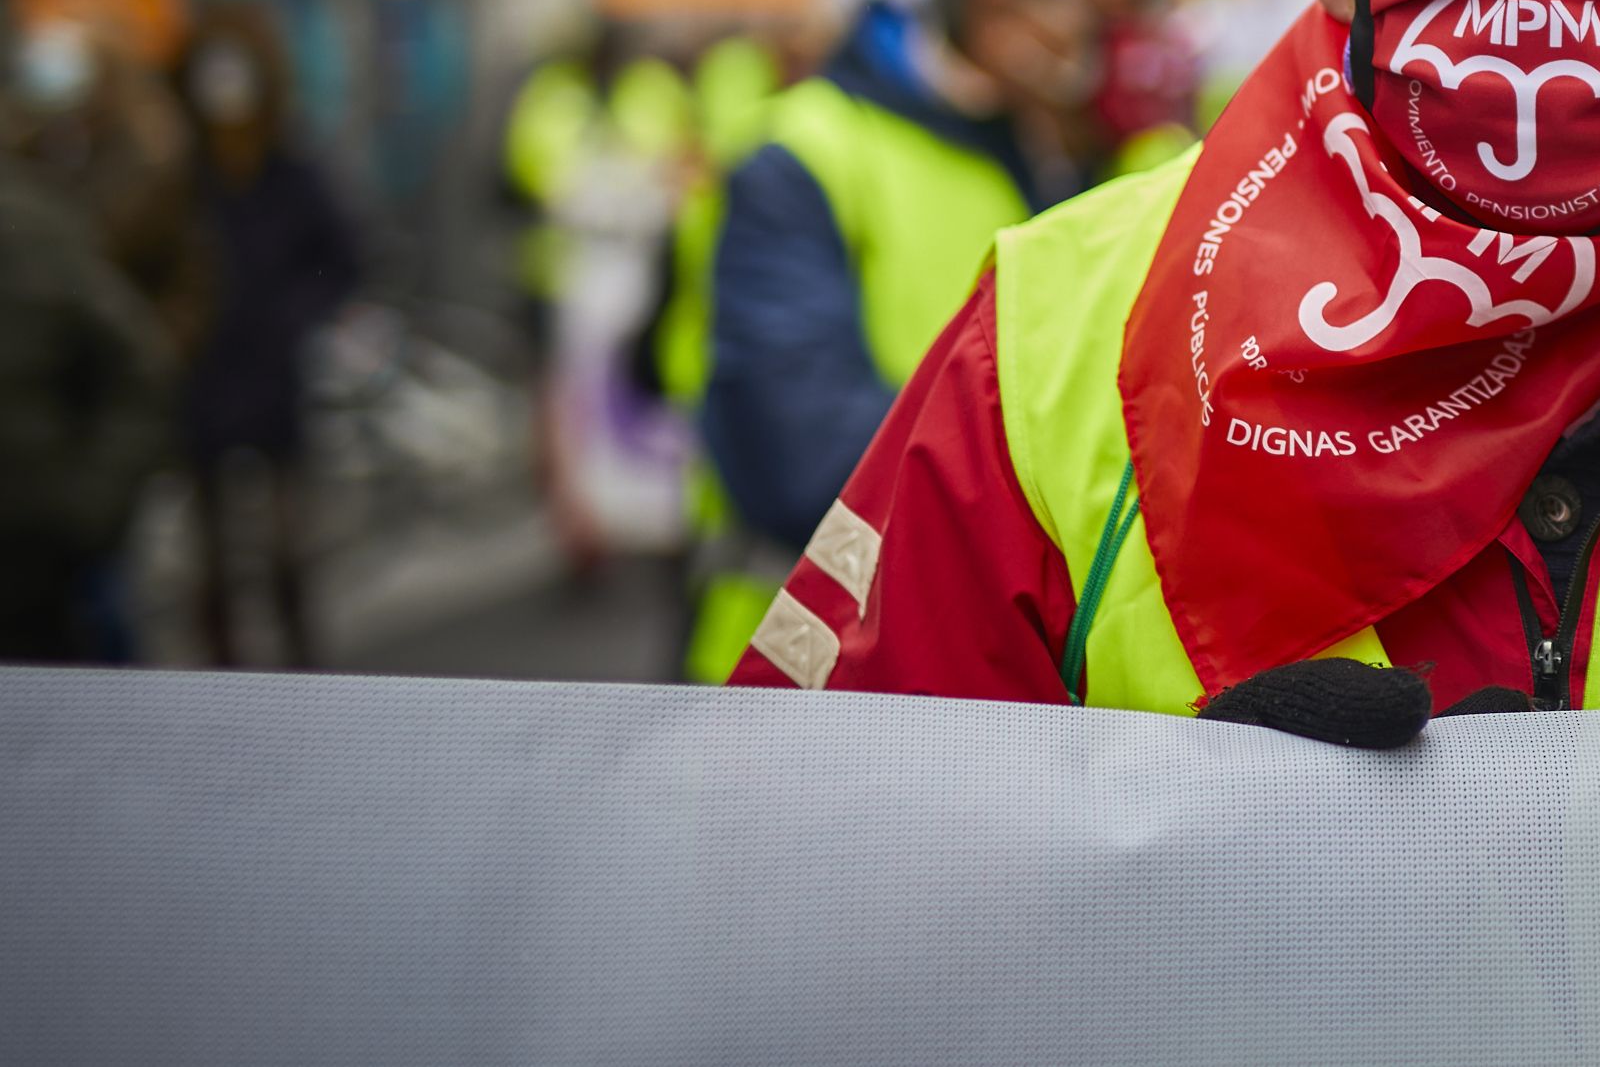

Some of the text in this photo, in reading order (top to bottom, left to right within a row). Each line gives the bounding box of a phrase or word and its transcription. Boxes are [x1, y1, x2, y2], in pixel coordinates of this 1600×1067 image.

[1407, 79, 1457, 192] OVIMIENTO
[1193, 132, 1298, 276] PENSIONES
[1240, 335, 1269, 372] POR
[1226, 418, 1357, 457] DIGNAS
